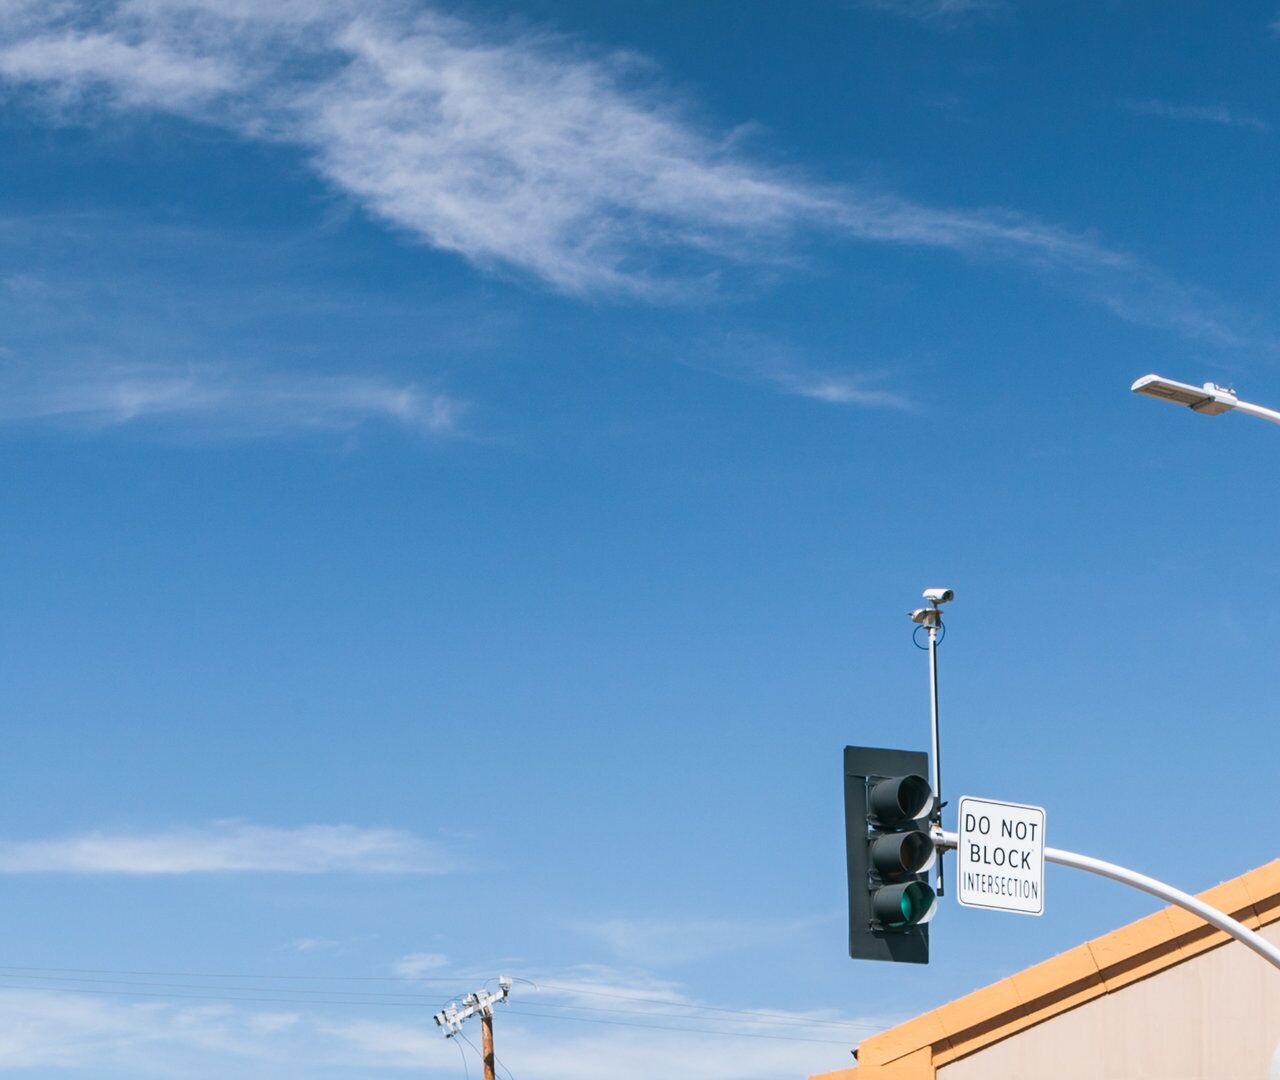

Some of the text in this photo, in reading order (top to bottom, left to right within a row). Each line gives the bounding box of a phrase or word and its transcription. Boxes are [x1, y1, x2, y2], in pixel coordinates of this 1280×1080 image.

[965, 813, 1038, 842] DO NOT
[970, 843, 1031, 870] BLOCK
[963, 871, 1038, 900] INTERSECTION
